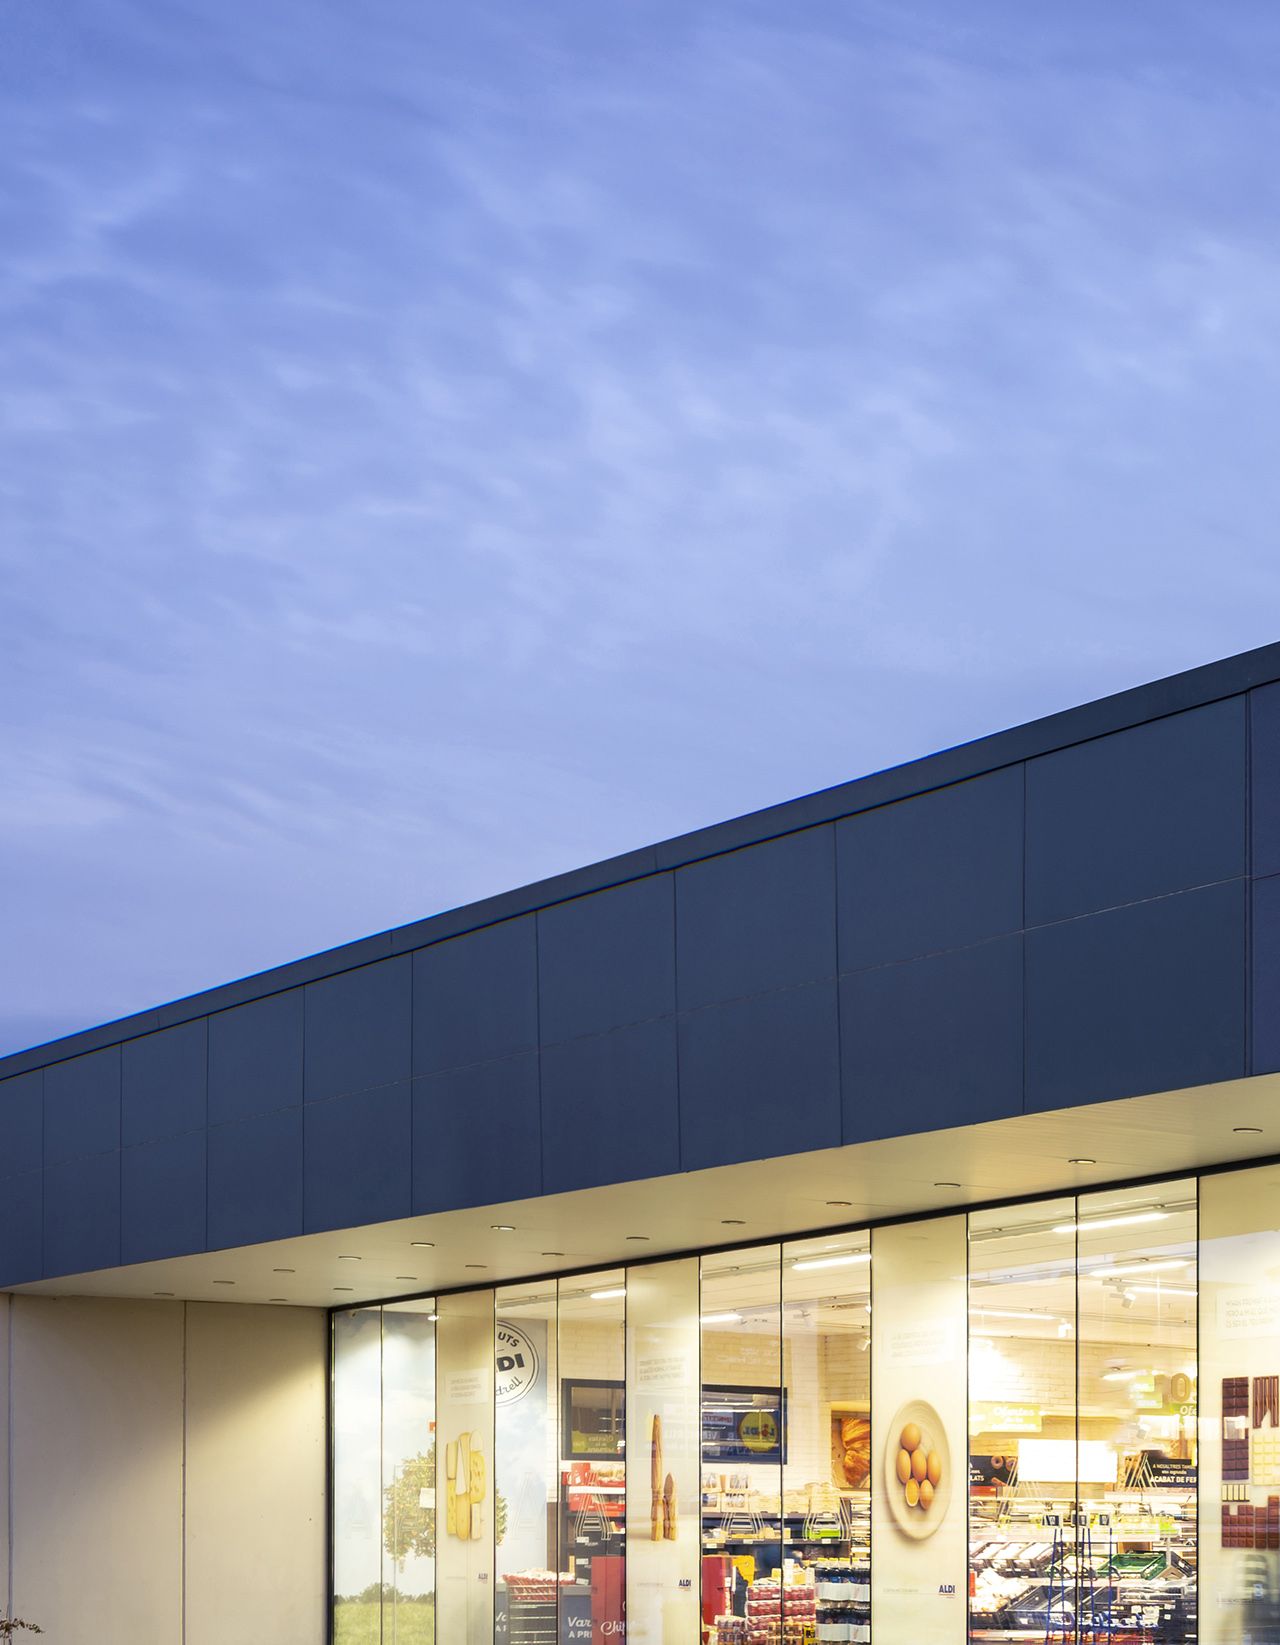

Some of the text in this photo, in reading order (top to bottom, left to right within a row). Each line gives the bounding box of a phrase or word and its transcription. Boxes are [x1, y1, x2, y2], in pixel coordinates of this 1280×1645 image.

[498, 1332, 520, 1348] UTS
[496, 1353, 525, 1372] DI
[678, 1578, 692, 1588] ALDI
[938, 1584, 956, 1594] ALDI
[577, 1630, 593, 1639] PR
